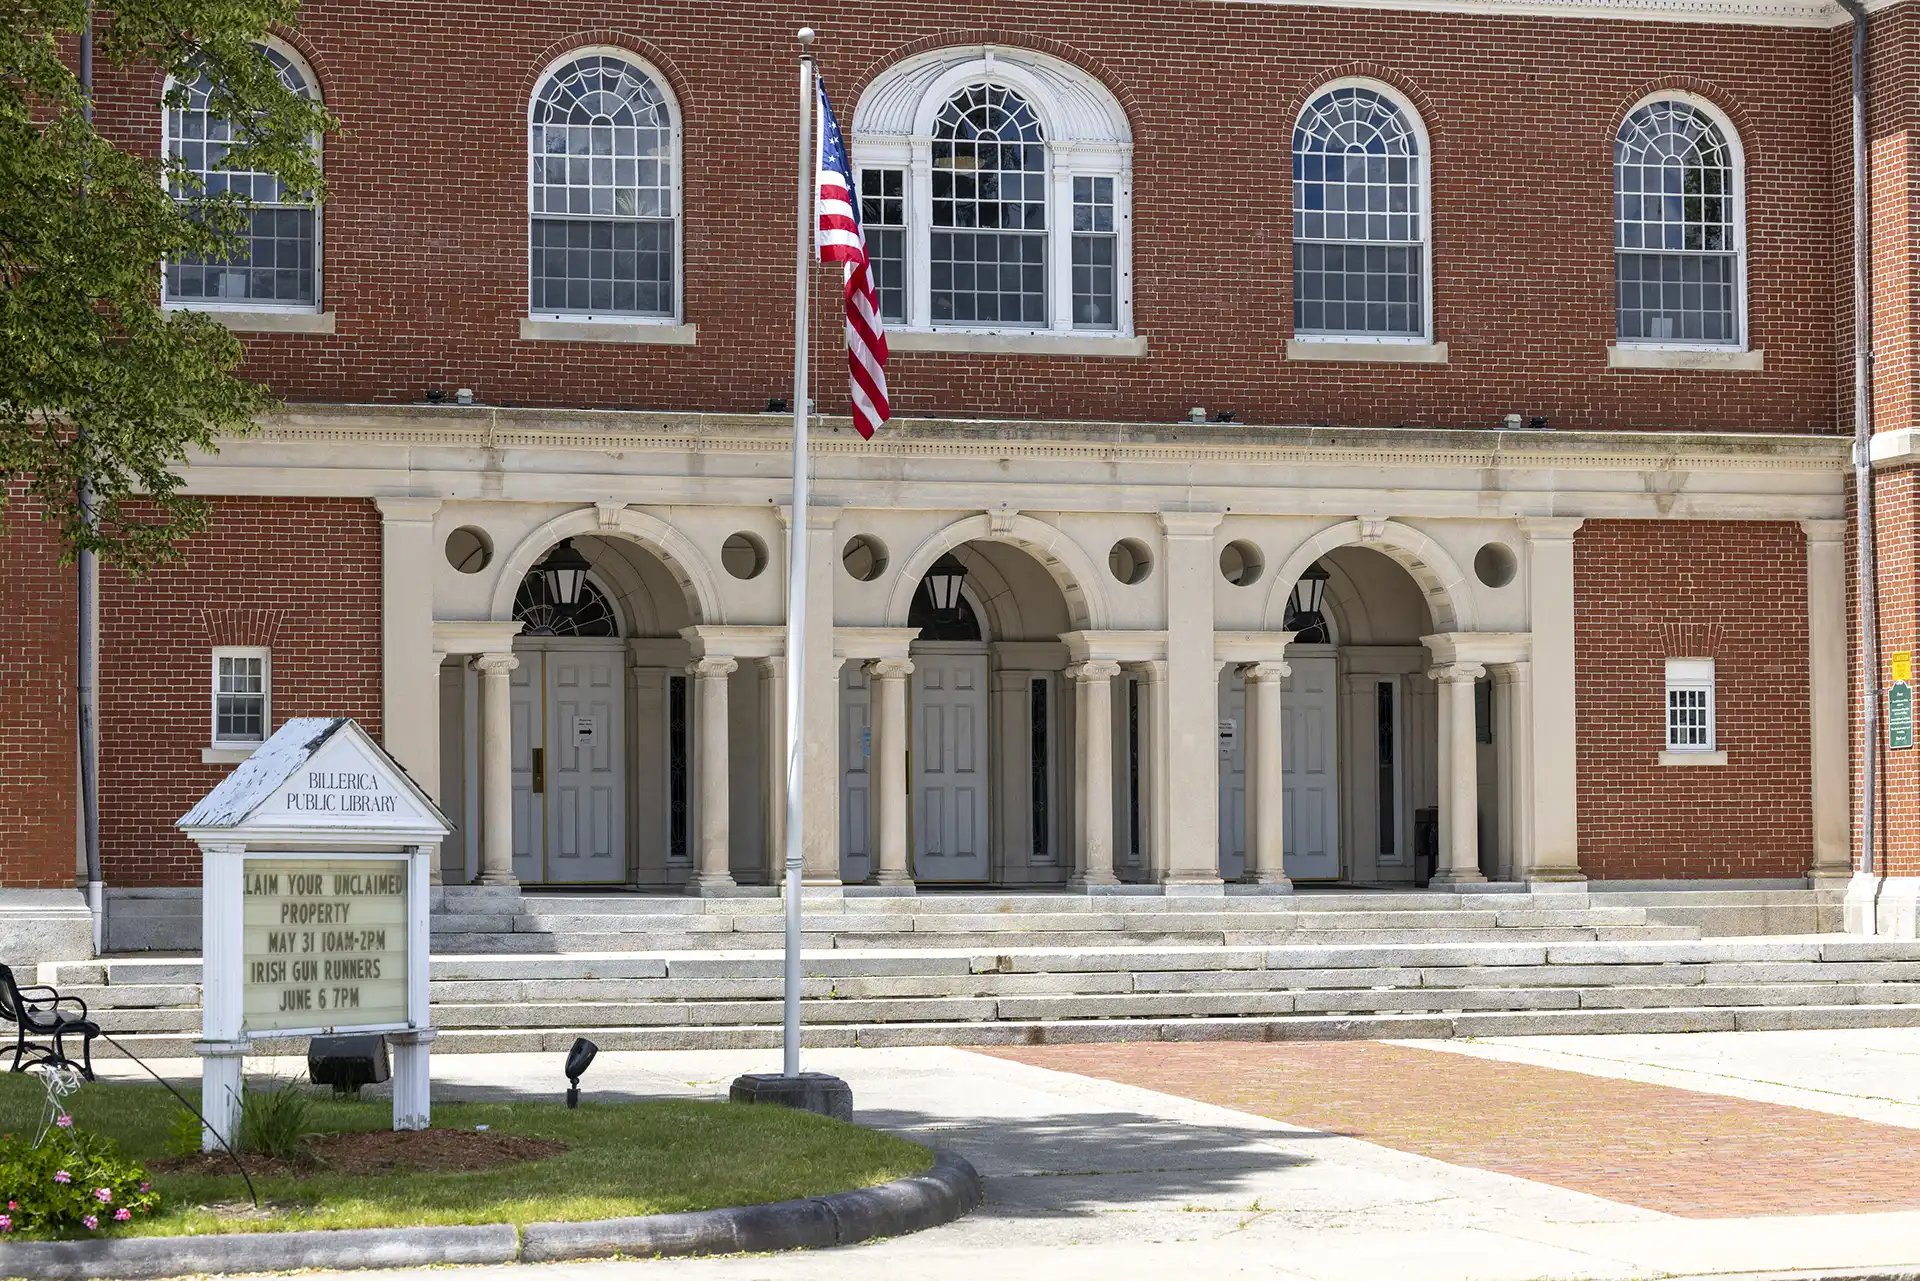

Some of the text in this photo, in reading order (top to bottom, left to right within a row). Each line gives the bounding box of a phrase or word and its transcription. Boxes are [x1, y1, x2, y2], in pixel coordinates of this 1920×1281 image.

[309, 772, 378, 790] BILLERICA
[287, 793, 397, 812] PUBLIC LIBRARY
[288, 873, 322, 895] YOUR
[334, 873, 402, 895] UNCLAIMED
[281, 902, 350, 924] PROPERTY
[268, 930, 385, 953] MAY 31 10AM-2PM
[251, 958, 381, 983] IRISH GUN RUNNERS
[279, 986, 360, 1011] JUNE 6 7PM
